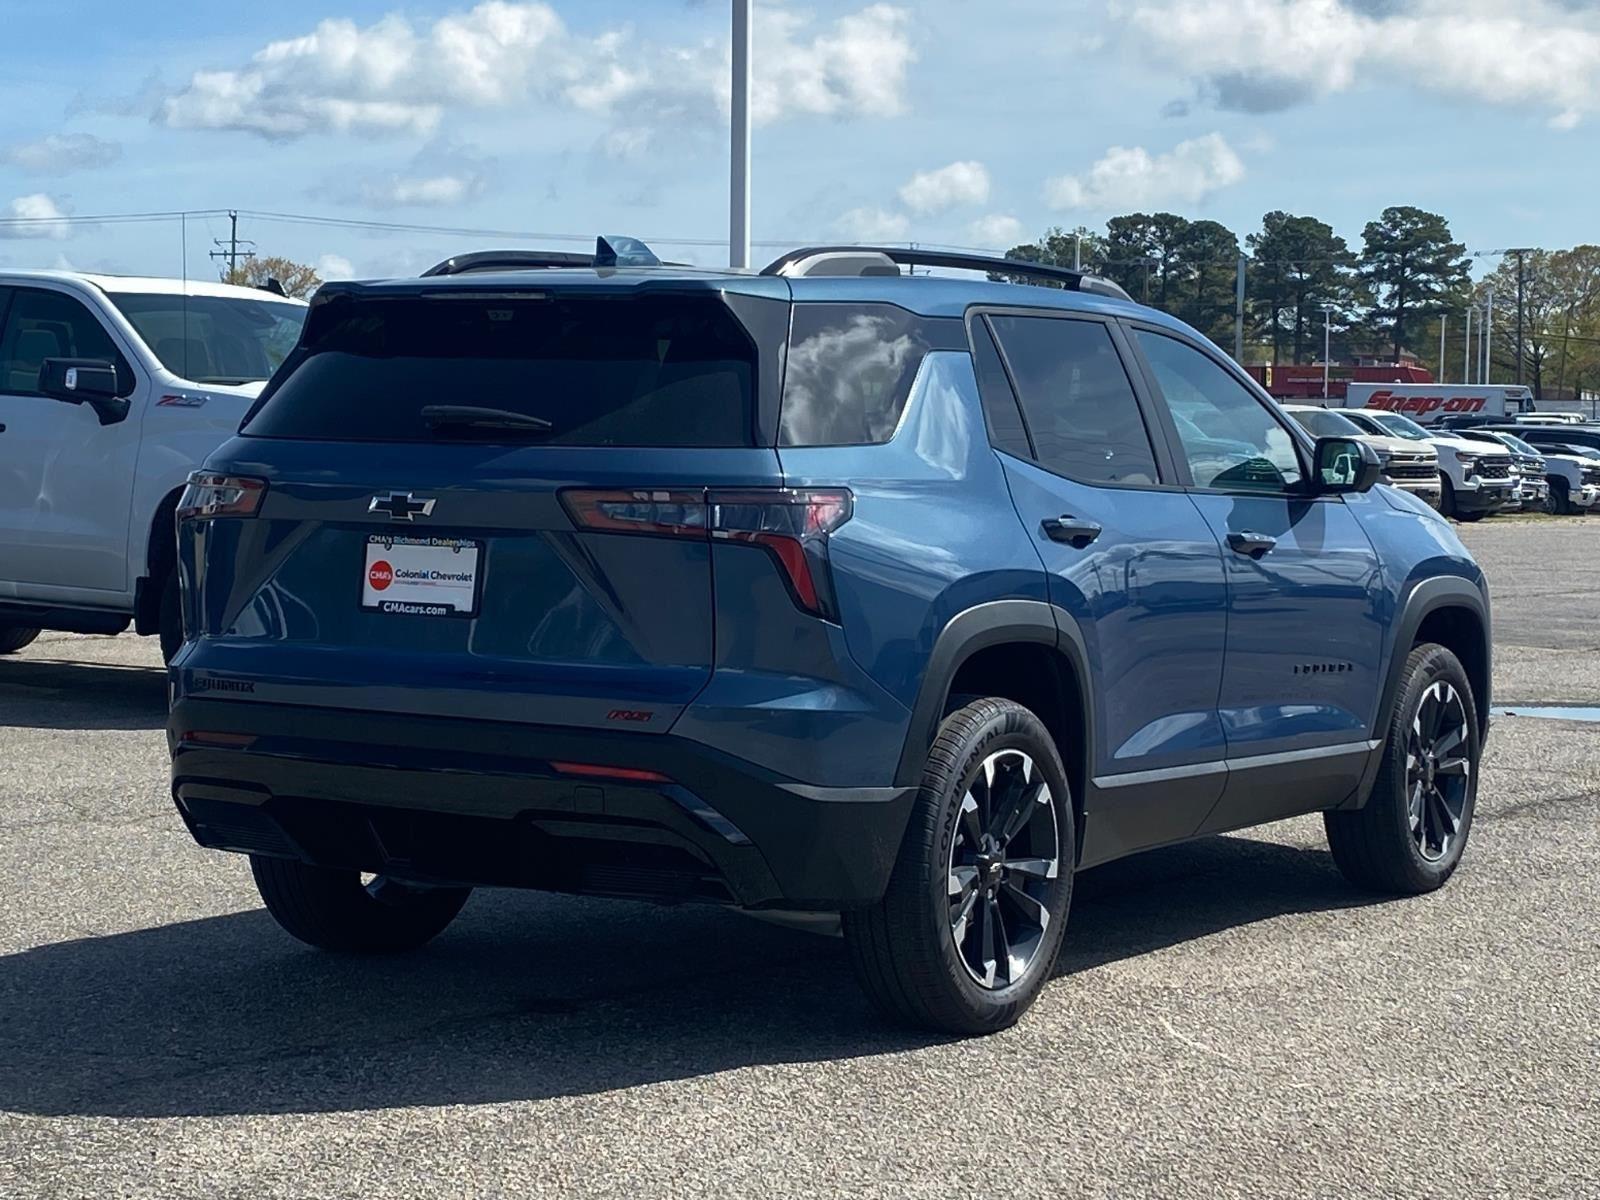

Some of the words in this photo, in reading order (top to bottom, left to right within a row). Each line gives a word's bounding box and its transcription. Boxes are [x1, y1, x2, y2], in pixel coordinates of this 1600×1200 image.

[1366, 390, 1487, 416] Snap-on
[369, 535, 392, 544] CMA's
[393, 536, 431, 545] Richmond
[432, 538, 476, 548] Dealerships
[395, 569, 429, 579] Colonial
[431, 571, 473, 582] Chevrolet
[383, 602, 447, 615] CMAcars.com
[938, 725, 1003, 869] CONTINENTAL
